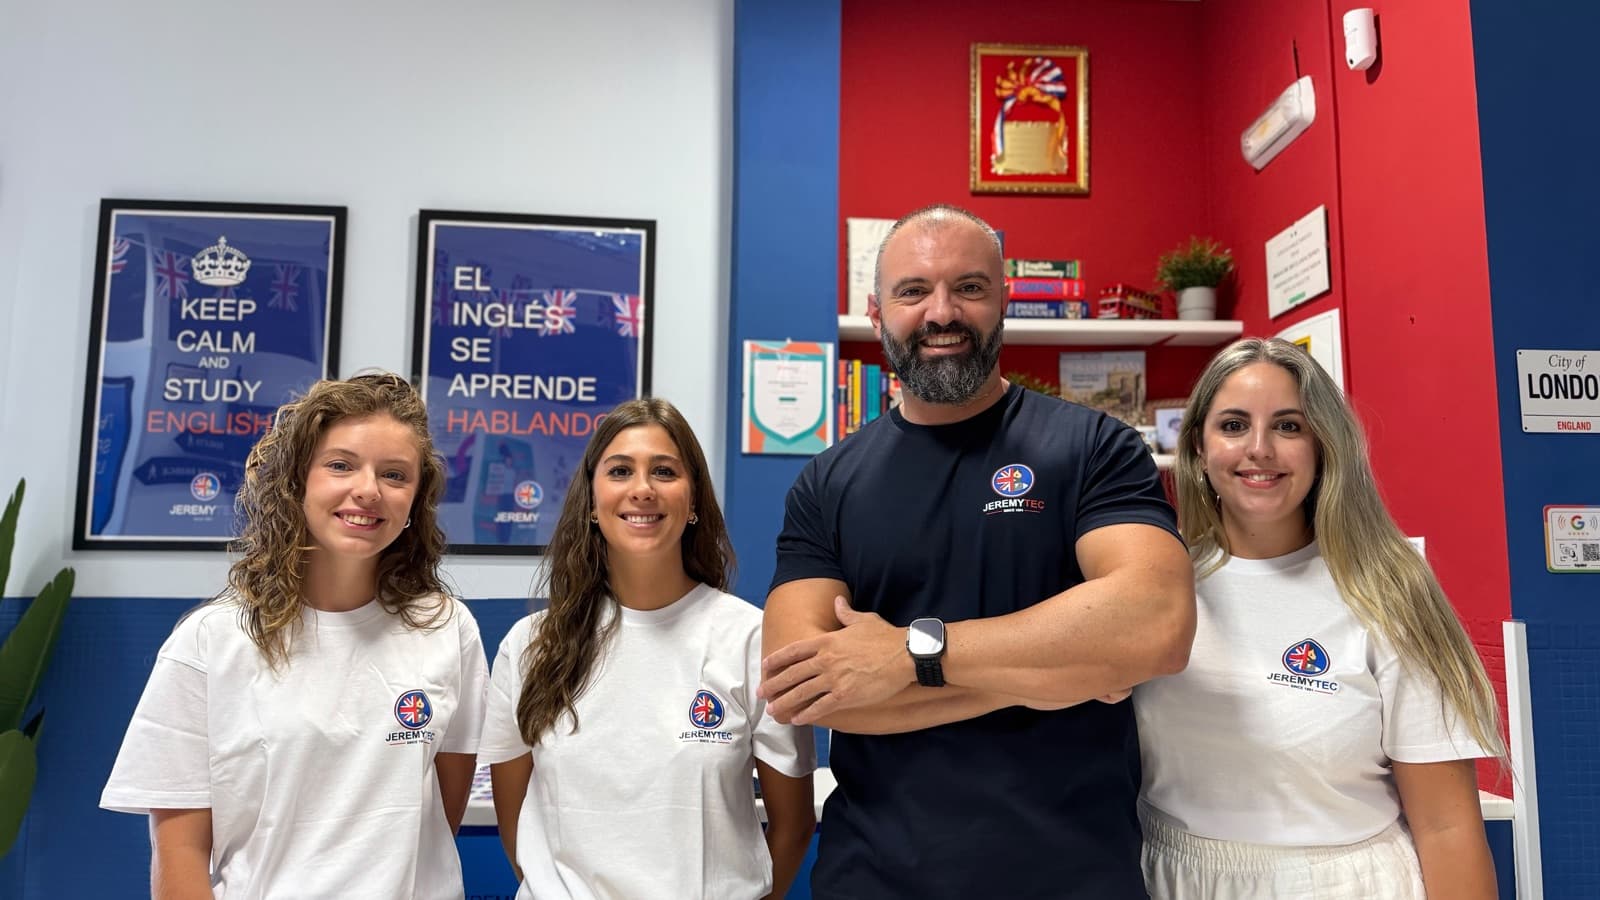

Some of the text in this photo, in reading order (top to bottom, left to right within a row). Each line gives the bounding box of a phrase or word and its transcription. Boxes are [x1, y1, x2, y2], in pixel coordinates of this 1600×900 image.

[454, 266, 491, 291] EL
[181, 298, 256, 321] KEEP
[452, 299, 563, 330] INGLÉS
[176, 329, 256, 354] CALM
[450, 337, 491, 363] SE
[198, 356, 230, 369] AND
[1548, 354, 1588, 372] City of
[163, 377, 262, 402] STUDY
[447, 373, 597, 402] APRENDE
[1528, 373, 1600, 400] LONDO
[146, 410, 273, 435] ENGLISH
[1557, 421, 1592, 431] ENGLAND
[982, 498, 1045, 512] JEREMYTEC
[1267, 672, 1338, 691] JEREMYTEC
[679, 729, 733, 741] JEREMYTEC
